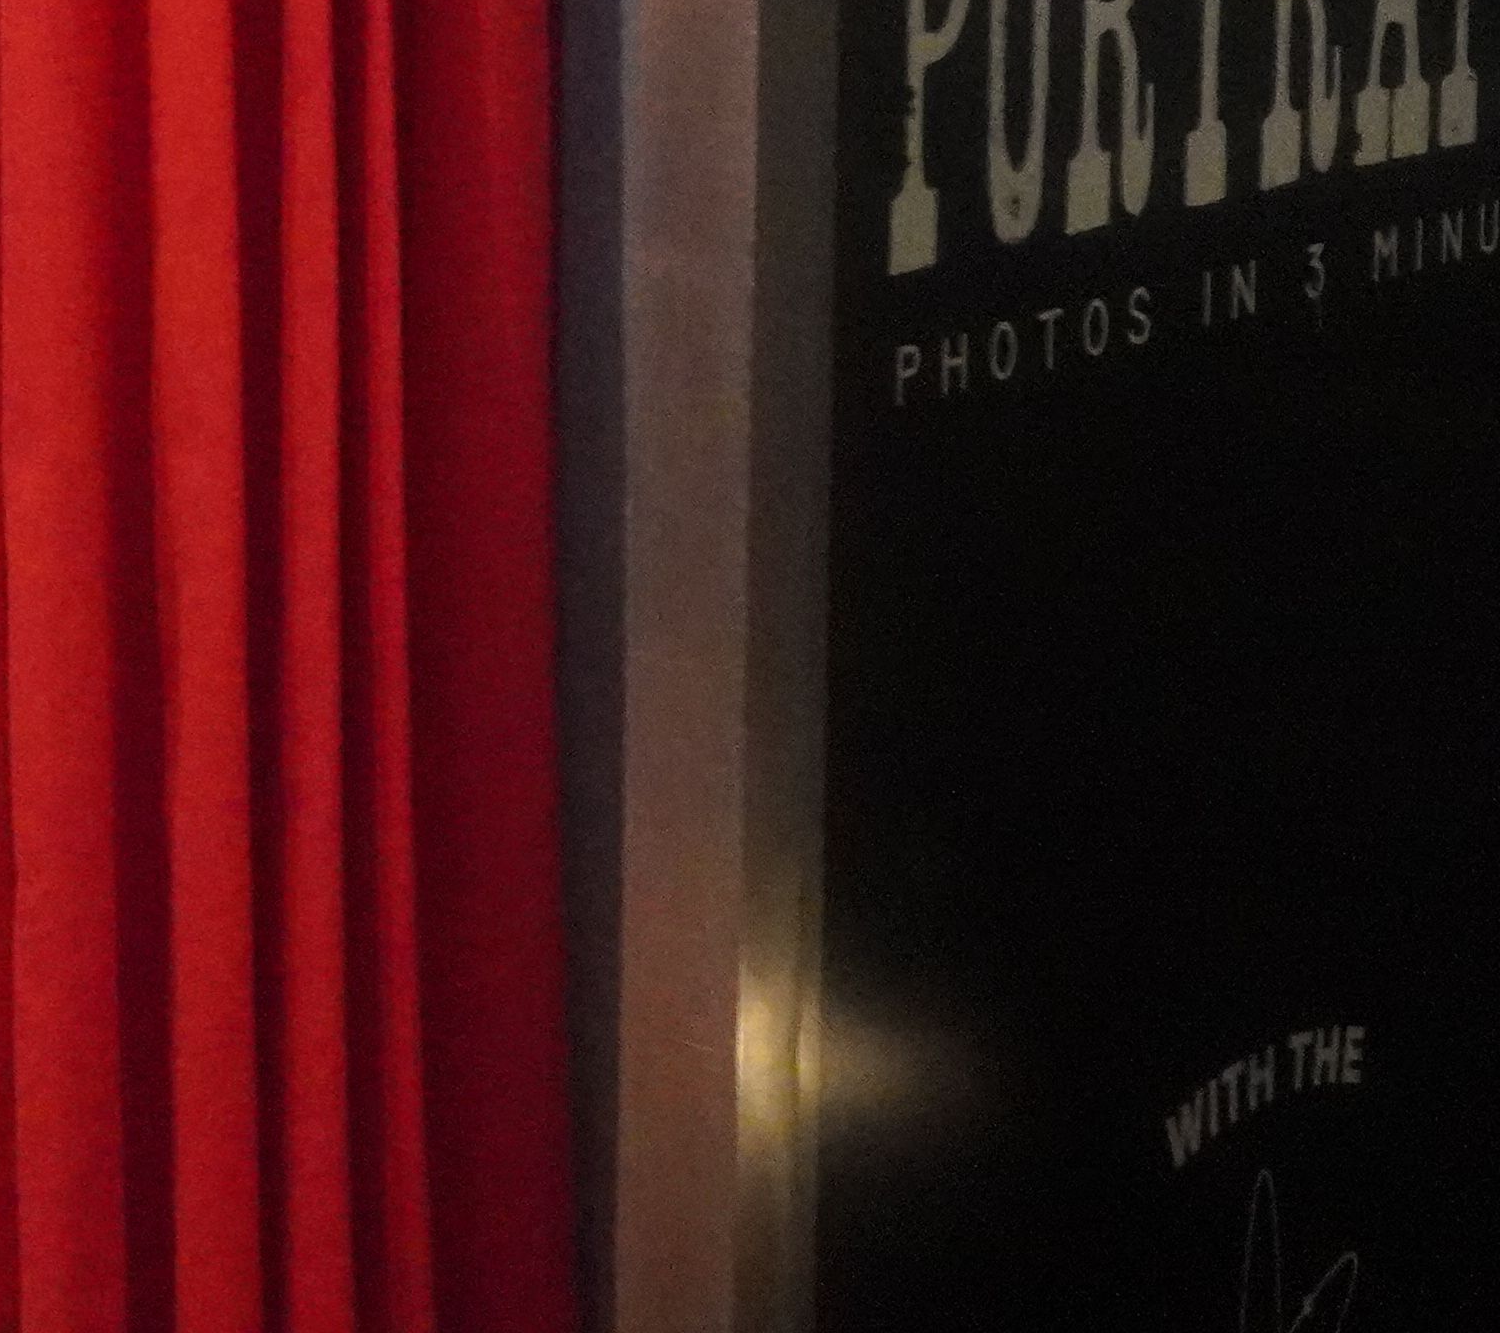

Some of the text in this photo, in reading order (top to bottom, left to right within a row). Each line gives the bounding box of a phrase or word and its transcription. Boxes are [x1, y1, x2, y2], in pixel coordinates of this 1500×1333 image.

[896, 287, 1154, 407] PHOTOS
[1202, 260, 1259, 327] IN
[1303, 241, 1327, 301] 3
[1165, 1023, 1367, 1168] WITH THE
